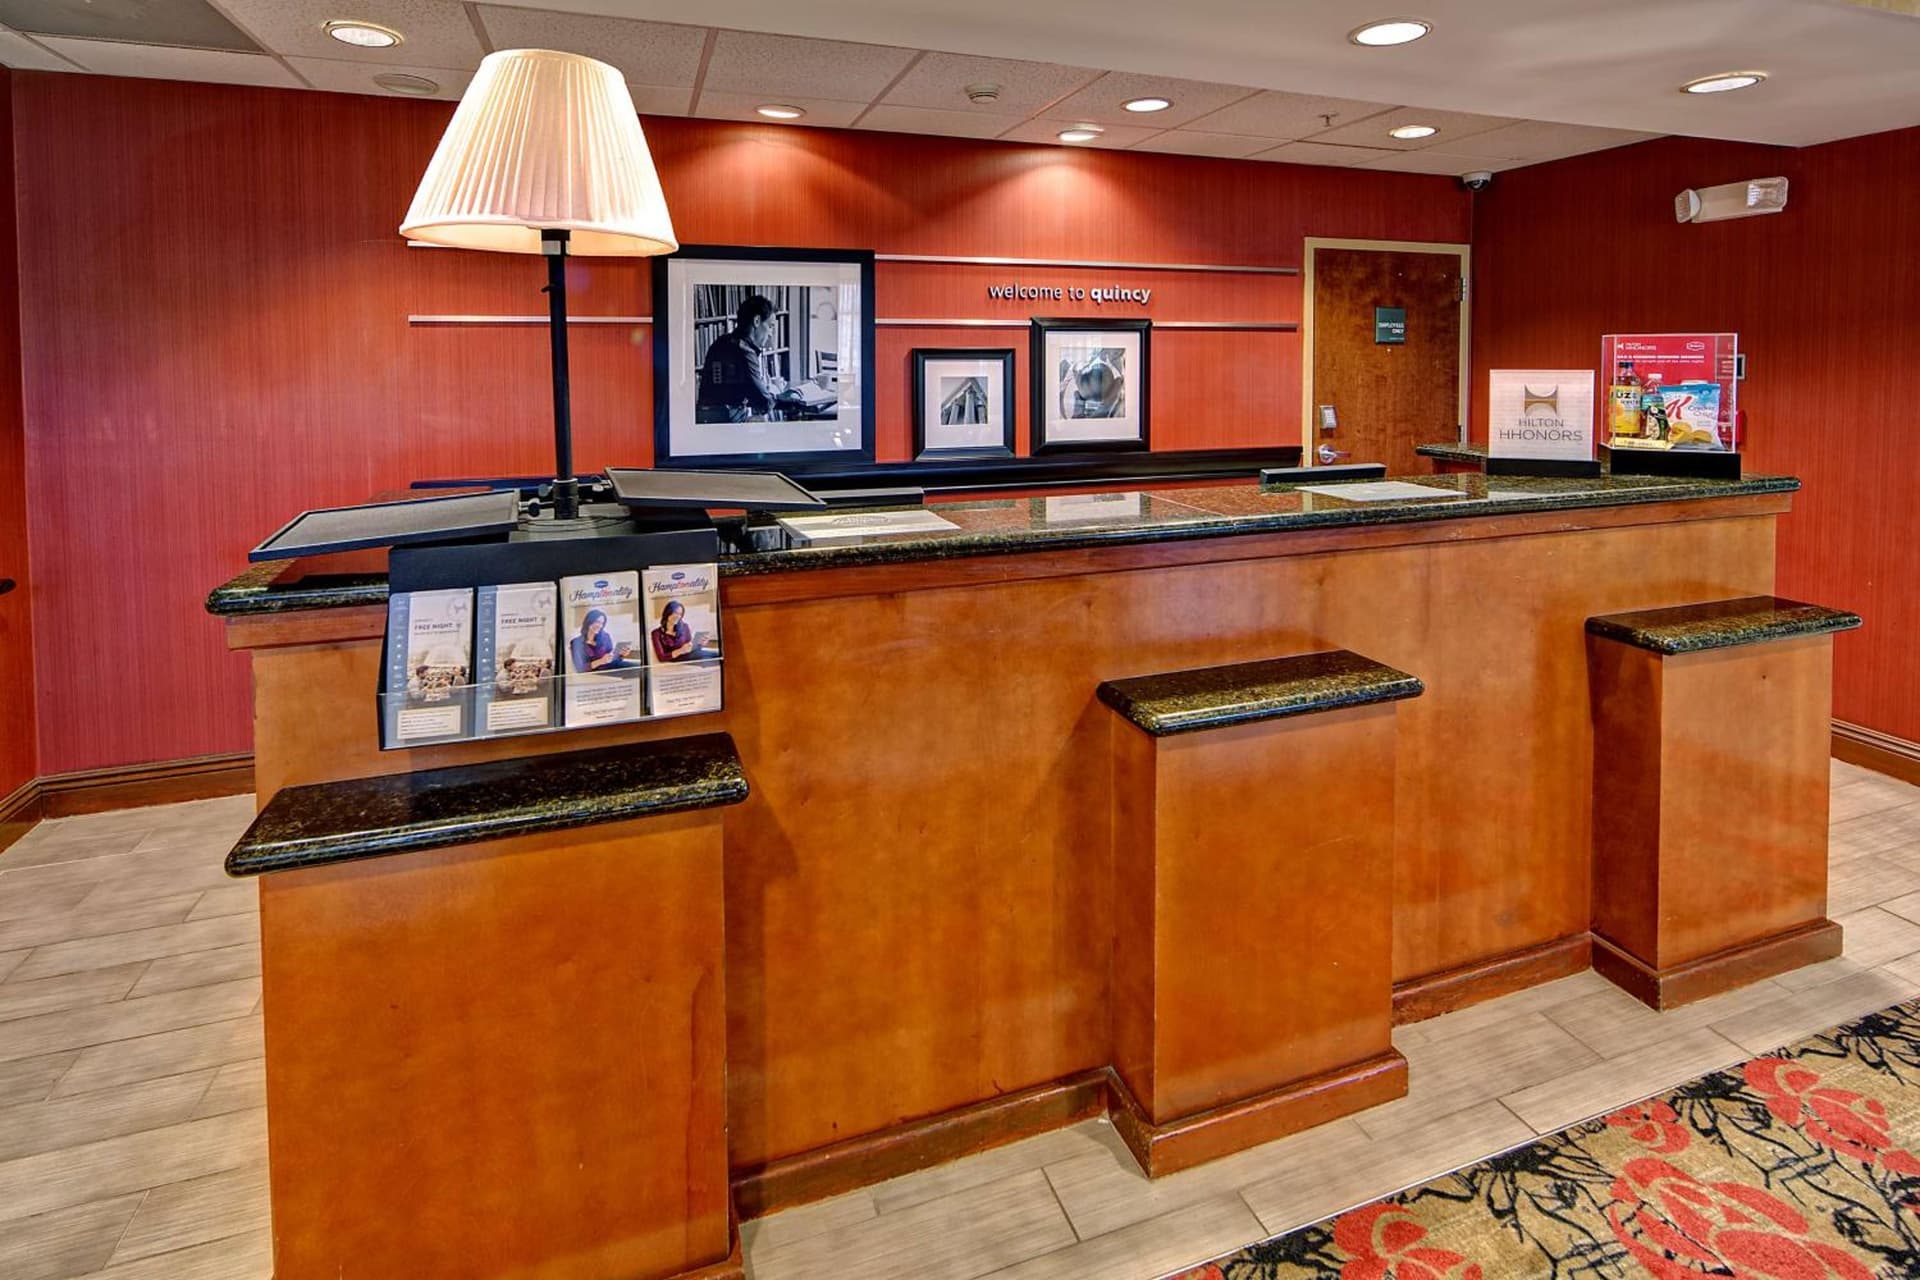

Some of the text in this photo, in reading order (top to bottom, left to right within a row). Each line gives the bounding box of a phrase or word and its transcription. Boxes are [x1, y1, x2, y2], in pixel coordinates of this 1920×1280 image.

[989, 284, 1151, 303] welcome to quincy
[1665, 395, 1693, 421] K
[1518, 418, 1565, 428] HILTON
[1499, 429, 1584, 441] HHONORS
[432, 622, 453, 630] NIGHT
